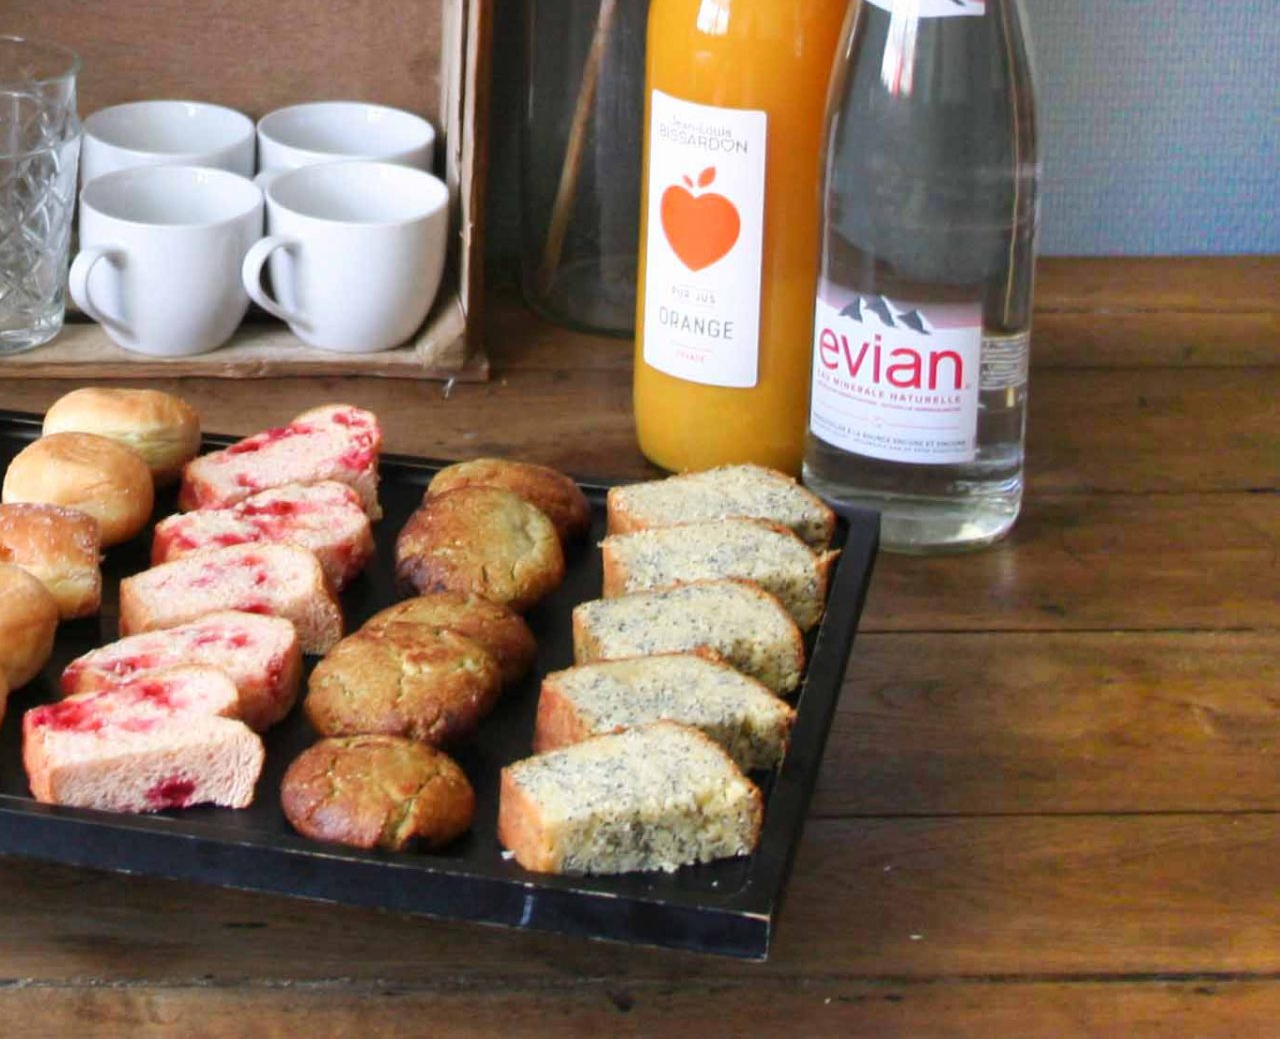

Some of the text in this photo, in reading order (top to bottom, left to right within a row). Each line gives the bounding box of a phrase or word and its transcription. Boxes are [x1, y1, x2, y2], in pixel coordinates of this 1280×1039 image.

[658, 305, 734, 340] ORANGE
[819, 327, 963, 390] evian
[889, 392, 962, 404] NATURELLE
